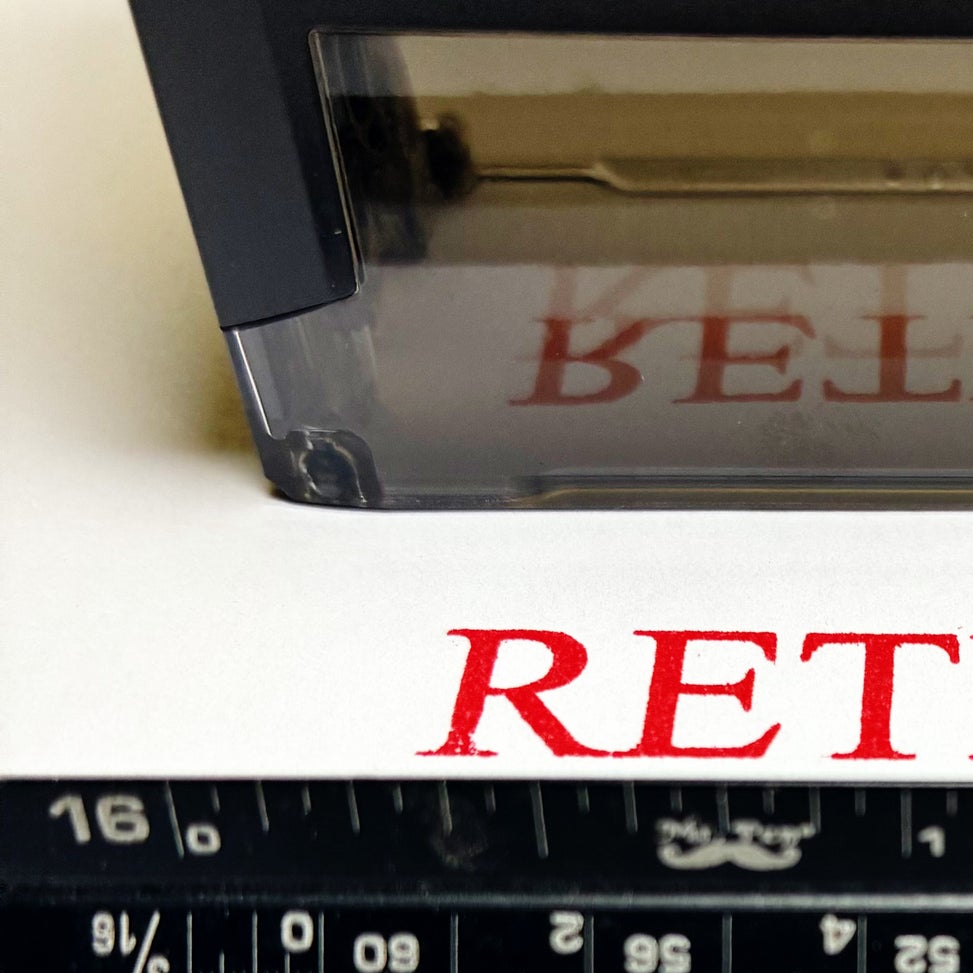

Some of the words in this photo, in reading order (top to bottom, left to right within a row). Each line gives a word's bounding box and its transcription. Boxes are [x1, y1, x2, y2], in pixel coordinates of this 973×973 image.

[49, 795, 150, 843] 16
[185, 824, 222, 854] 0
[919, 827, 946, 856] 1
[280, 911, 315, 952] 0
[549, 910, 585, 954] 2
[819, 913, 858, 955] 4
